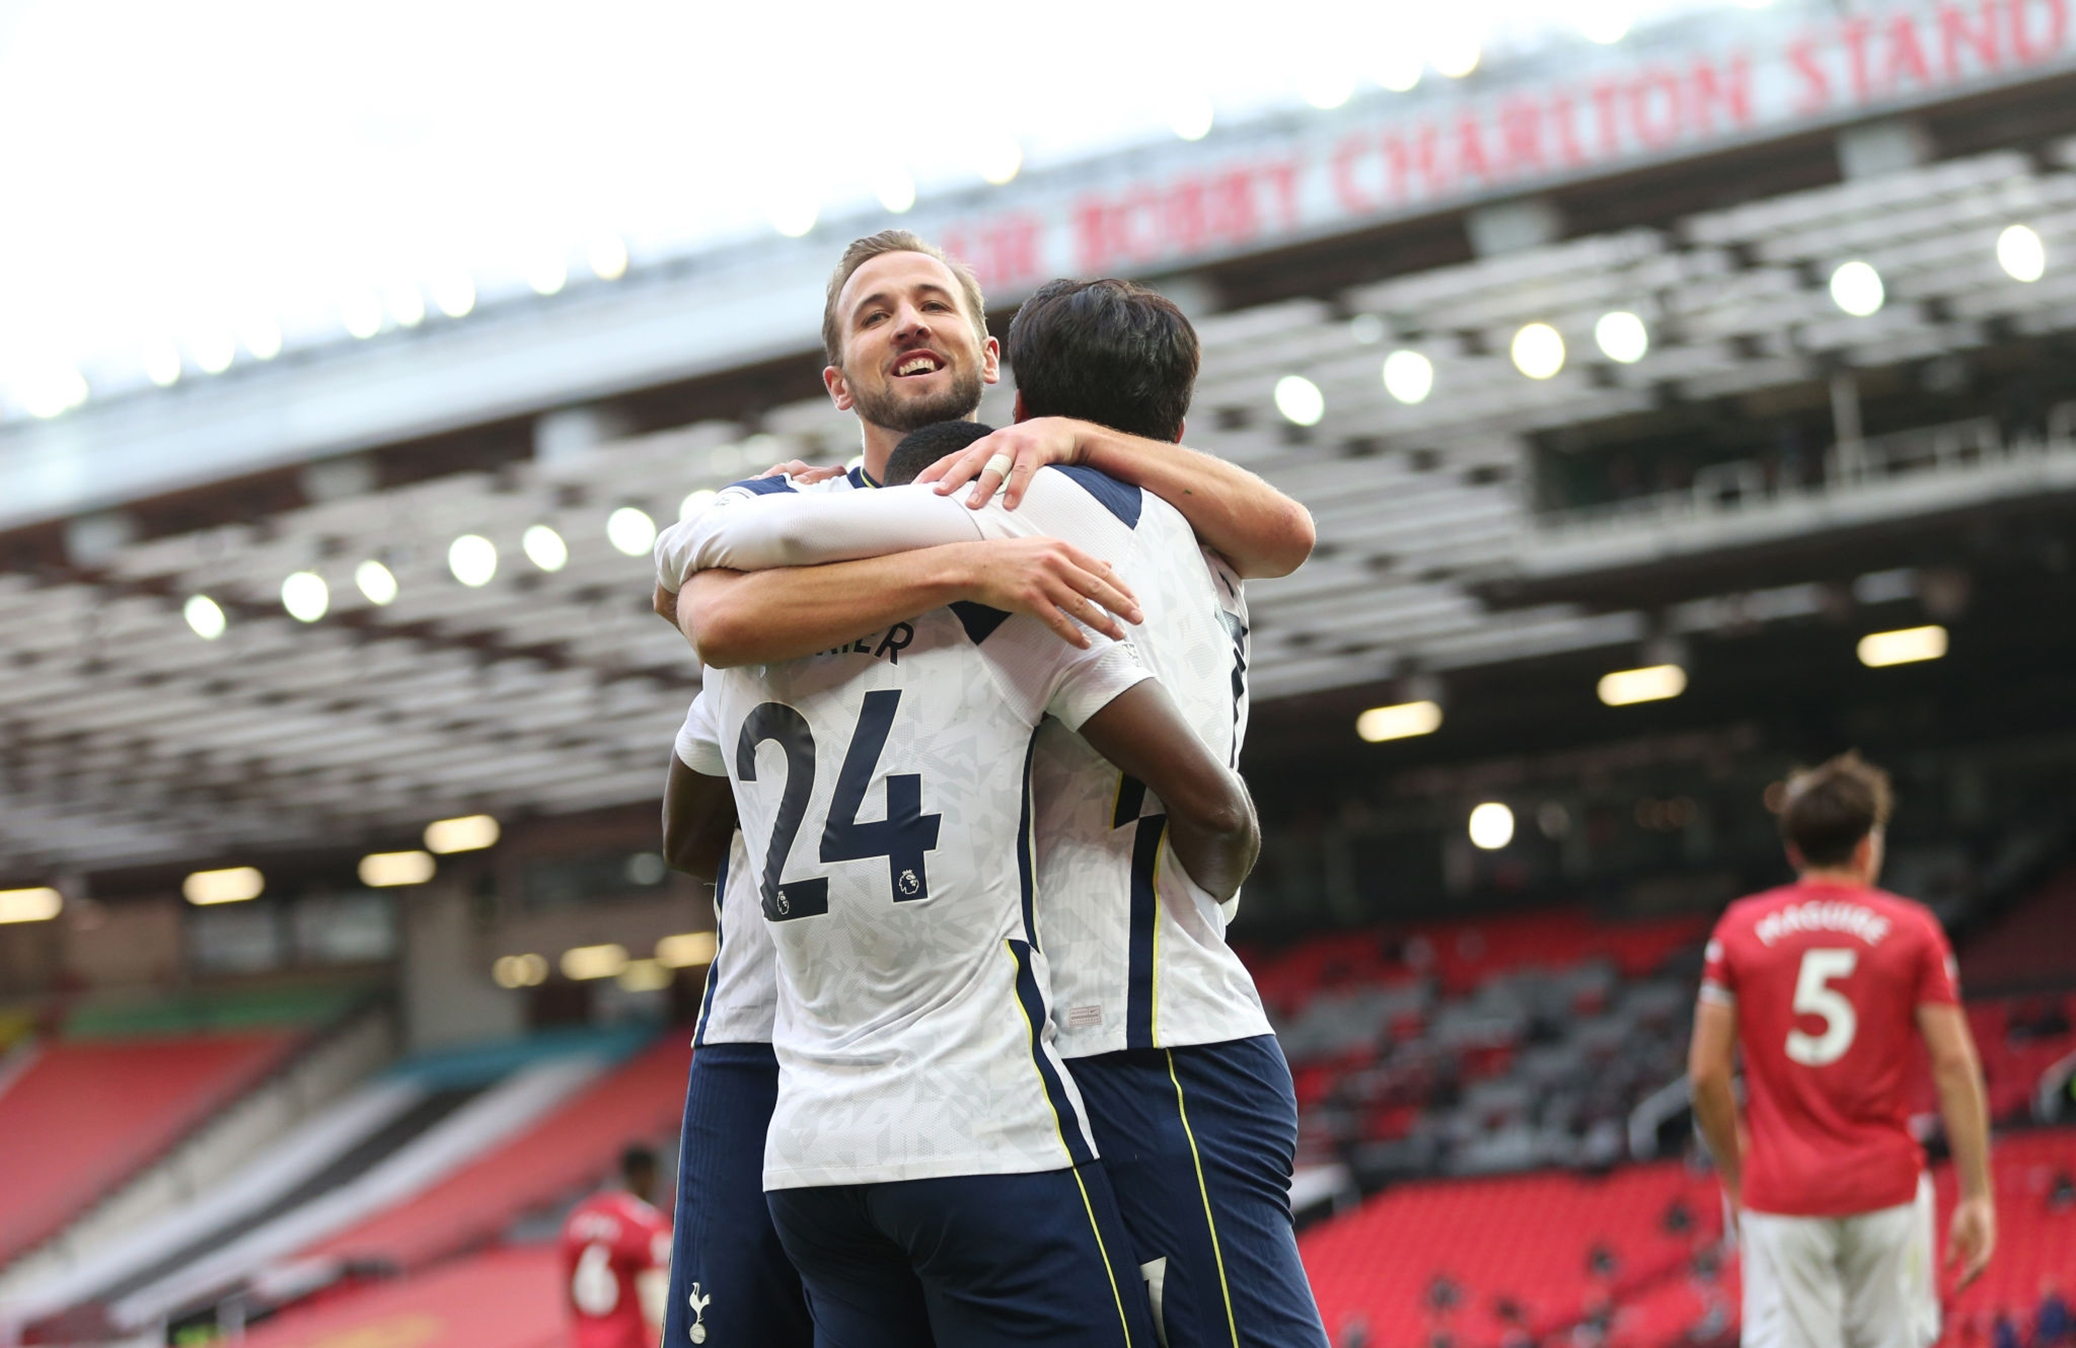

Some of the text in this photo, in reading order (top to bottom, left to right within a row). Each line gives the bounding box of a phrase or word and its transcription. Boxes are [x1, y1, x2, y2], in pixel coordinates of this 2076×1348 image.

[1070, 150, 1302, 275] BOBBY
[1330, 45, 1756, 216] CHARLTON
[1785, 0, 2069, 116] STAND
[736, 689, 943, 922] 24
[1754, 900, 1894, 948] MAGUIRE
[1784, 947, 1859, 1068] 5
